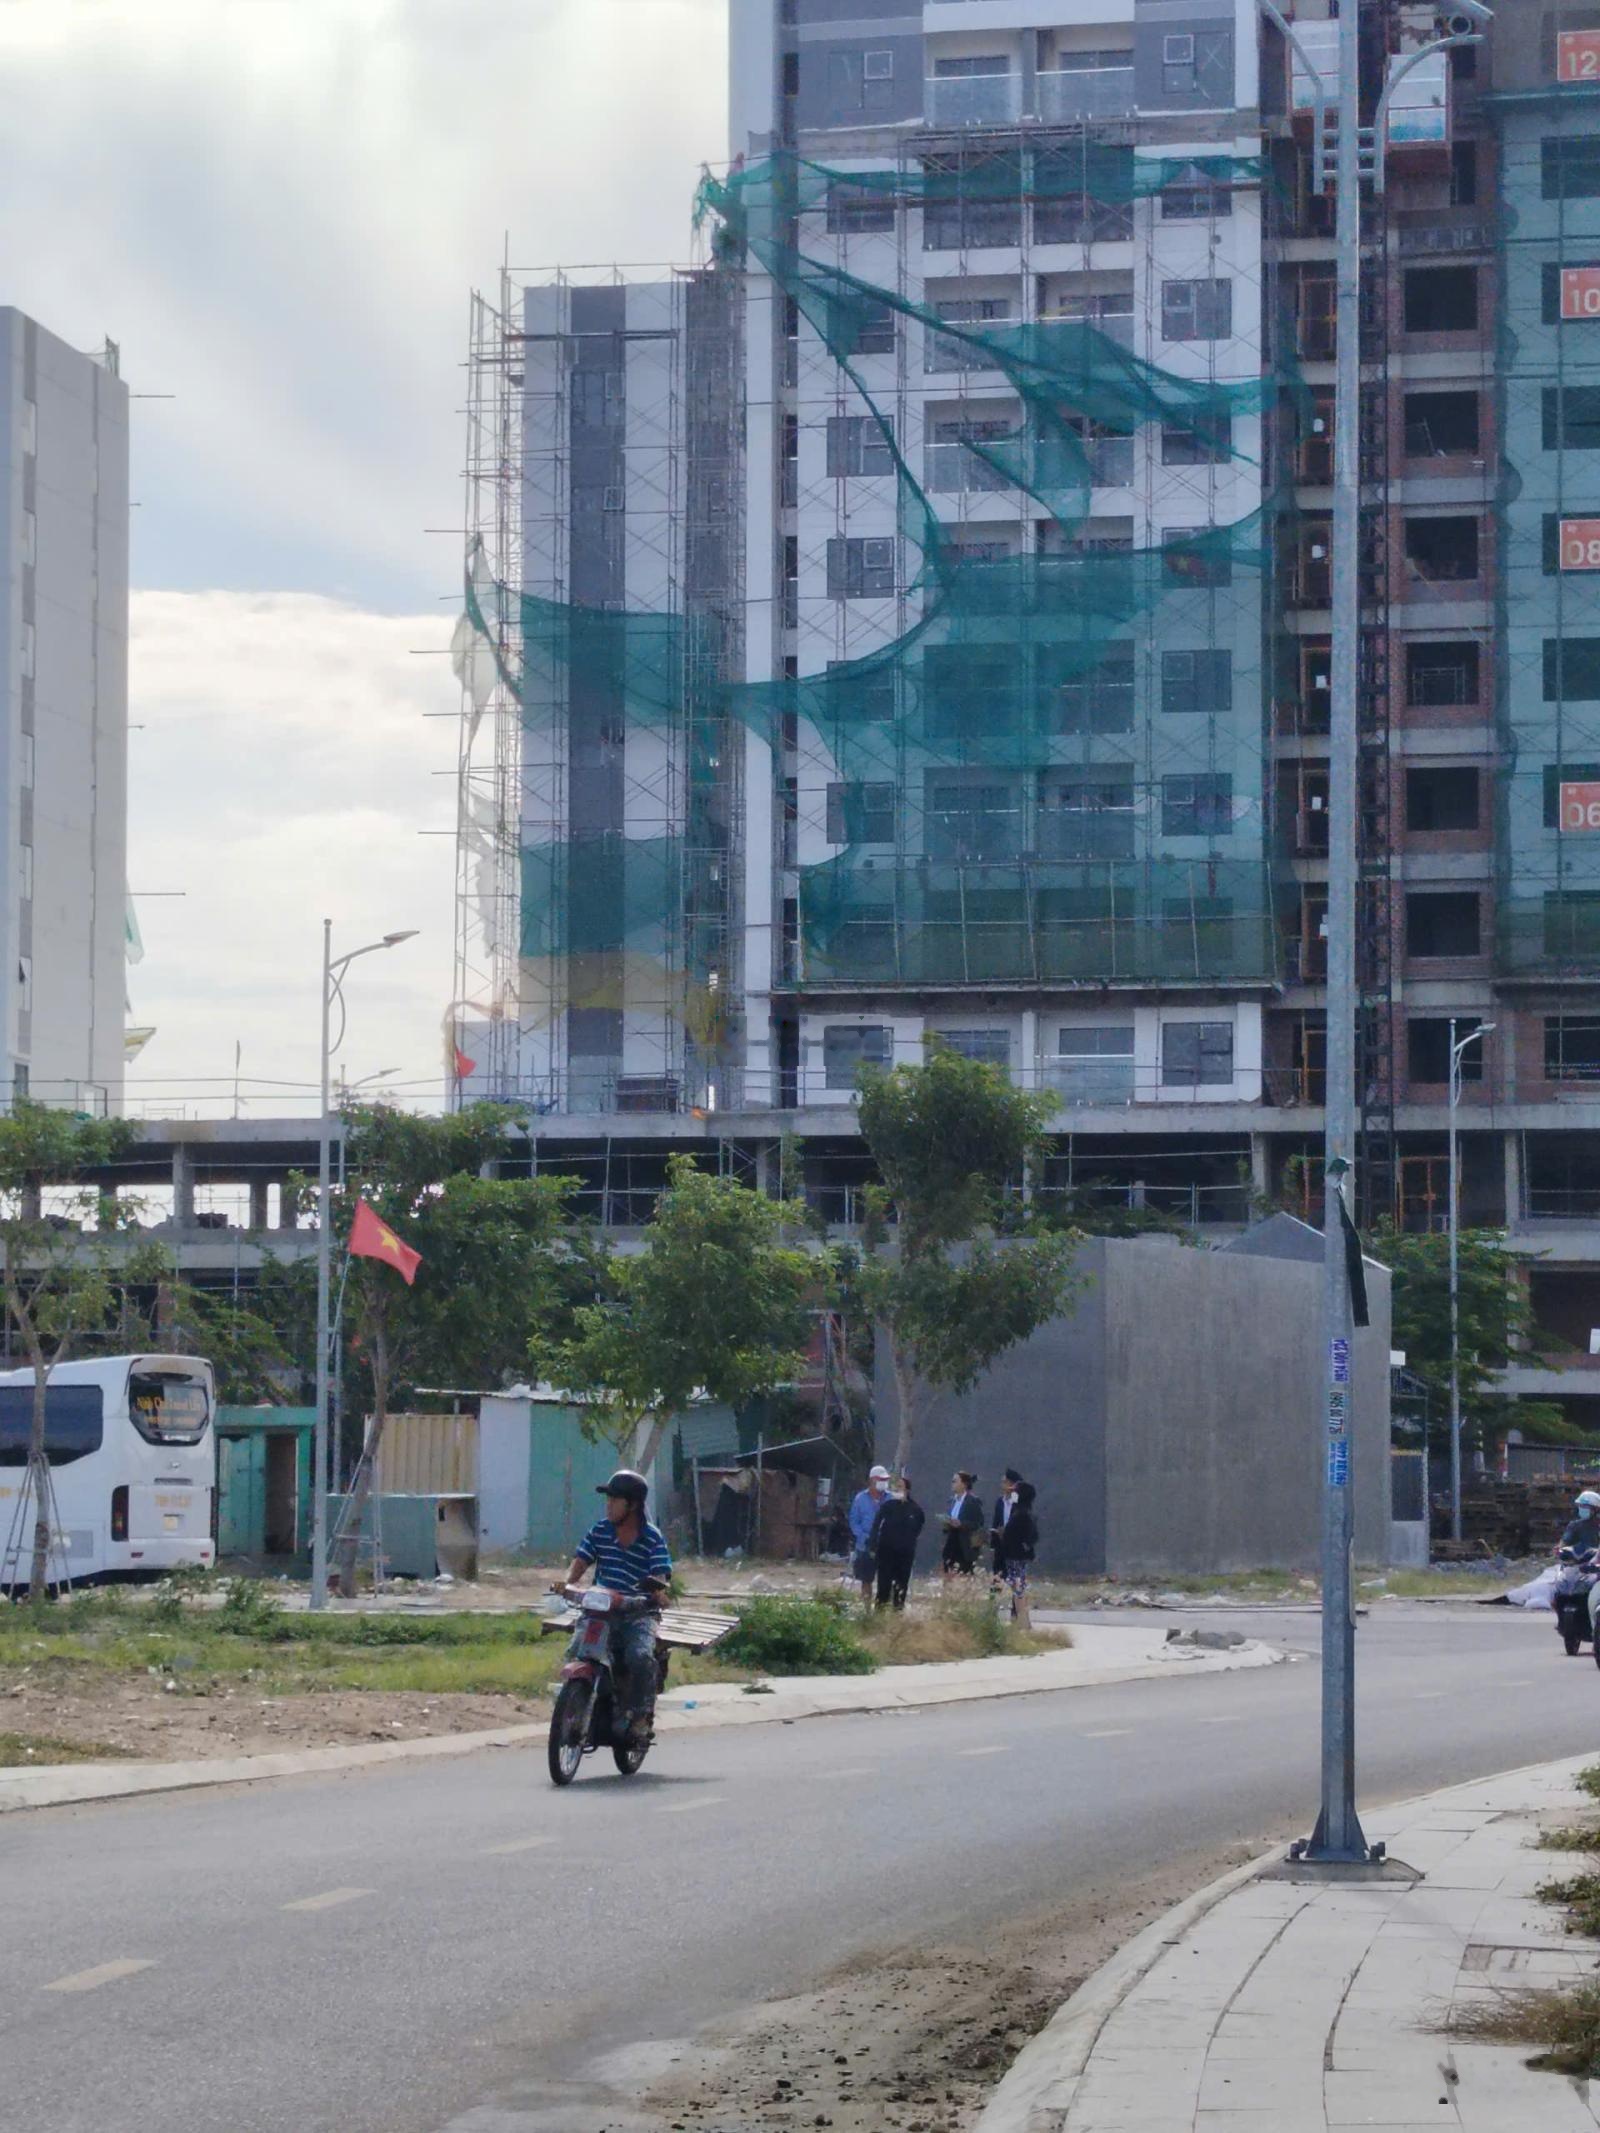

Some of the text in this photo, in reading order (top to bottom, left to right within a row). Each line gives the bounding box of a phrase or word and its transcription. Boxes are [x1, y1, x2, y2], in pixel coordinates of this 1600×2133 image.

[1567, 49, 1598, 77] 12
[1572, 288, 1600, 313] 10
[1566, 539, 1600, 565] 08
[1567, 801, 1600, 828] 06
